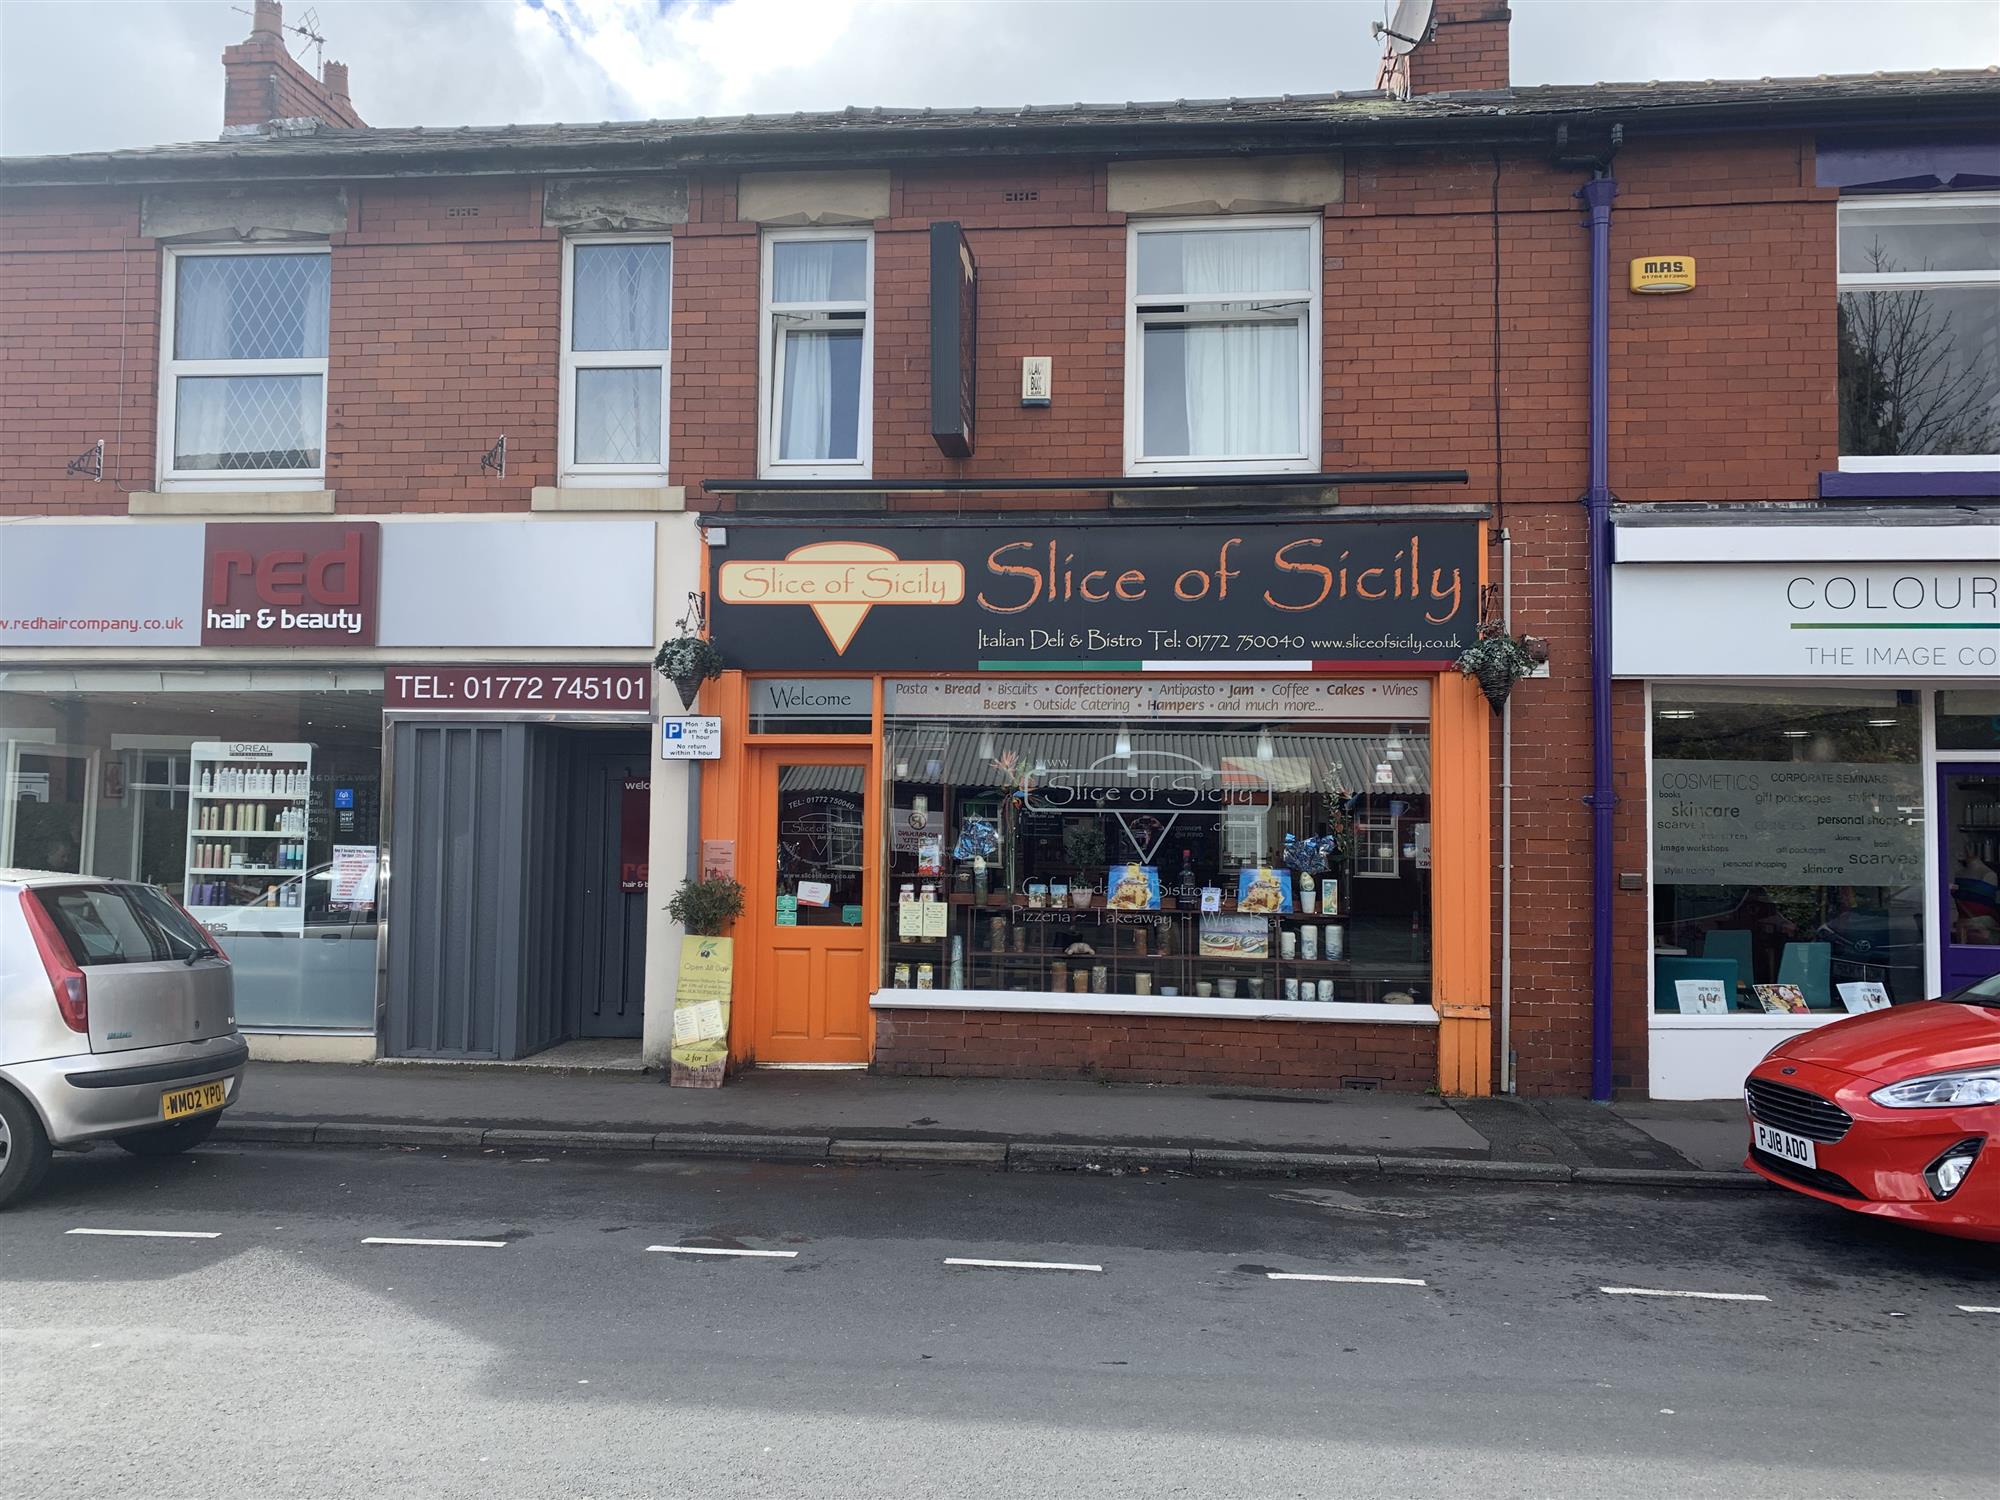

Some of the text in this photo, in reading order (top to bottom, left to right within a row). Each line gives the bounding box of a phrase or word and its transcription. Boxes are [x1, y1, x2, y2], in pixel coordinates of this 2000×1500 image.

[212, 530, 362, 607] red
[976, 535, 1462, 625] Slice of Sicily
[737, 566, 947, 601] Slice of Sicily
[1786, 576, 1998, 610] COLOUR
[207, 608, 362, 634] hair & beauty
[977, 628, 1462, 654] Italian Deli & Bistro Tel: 01772 750040 www.sliceofsicily.co.uk
[1804, 646, 1854, 666] THE
[1865, 646, 1947, 666] IMAGE
[395, 674, 645, 700] TEL: 01772 745101
[769, 685, 852, 709] Welcome
[895, 683, 1419, 699] Pasta Bread Biscuits Confectionery Antipasto Jam Coffee Cakes Wines
[983, 699, 1017, 711] Beers
[1033, 699, 1077, 711] Outside
[1081, 699, 1131, 714] Catering
[1147, 699, 1205, 714] Hampers
[1217, 699, 1240, 712] and
[1245, 699, 1279, 712] much
[1044, 774, 1253, 808] Slice of Sicily
[1662, 772, 1760, 791] COSMETICS
[1770, 772, 1889, 784] CORPORATE SEMINARS
[1671, 801, 1741, 818] skincare
[1817, 815, 1865, 826] personal
[1848, 853, 1919, 865] scarves
[1012, 905, 1071, 925] Pizzeria
[1091, 906, 1173, 931] Takeaway
[169, 1084, 221, 1115] WM02 YPO
[1759, 1126, 1808, 1162] PJ18 ADO
